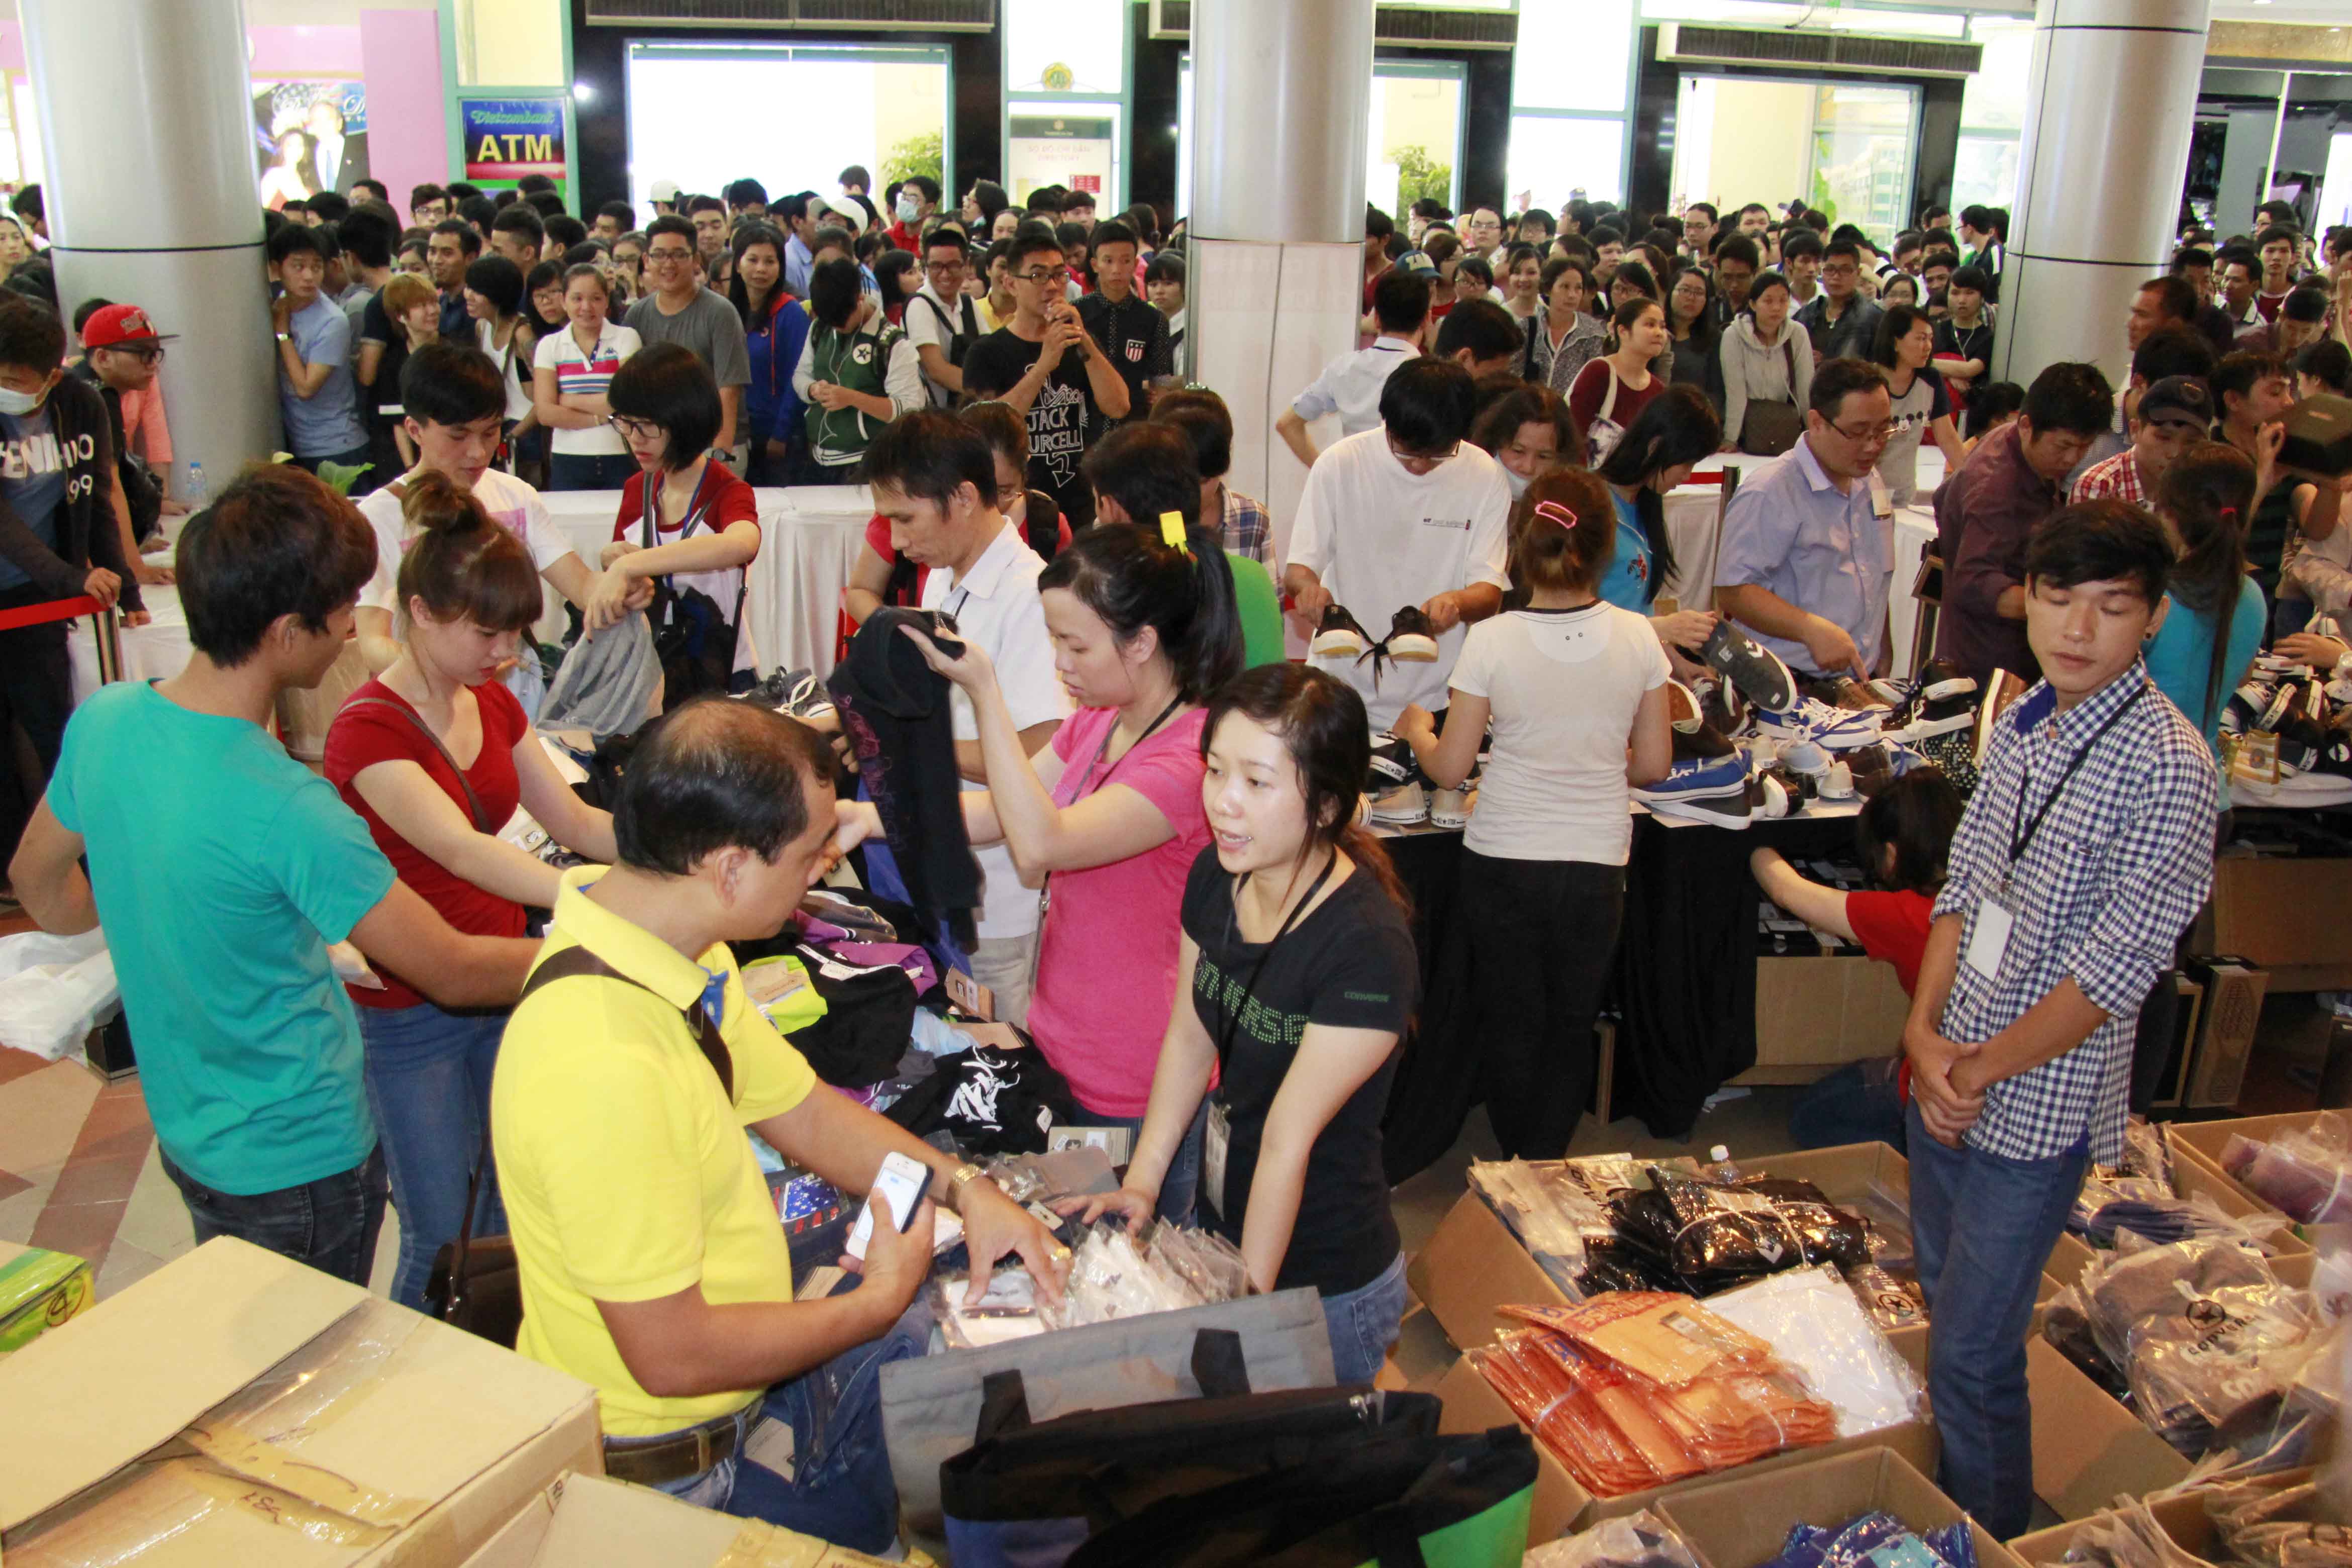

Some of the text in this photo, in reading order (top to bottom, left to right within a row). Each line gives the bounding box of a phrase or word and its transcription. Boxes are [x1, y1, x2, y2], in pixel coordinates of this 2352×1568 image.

[477, 134, 552, 162] ATM
[1027, 406, 1069, 432] JACK
[1029, 430, 1081, 453] URCELL
